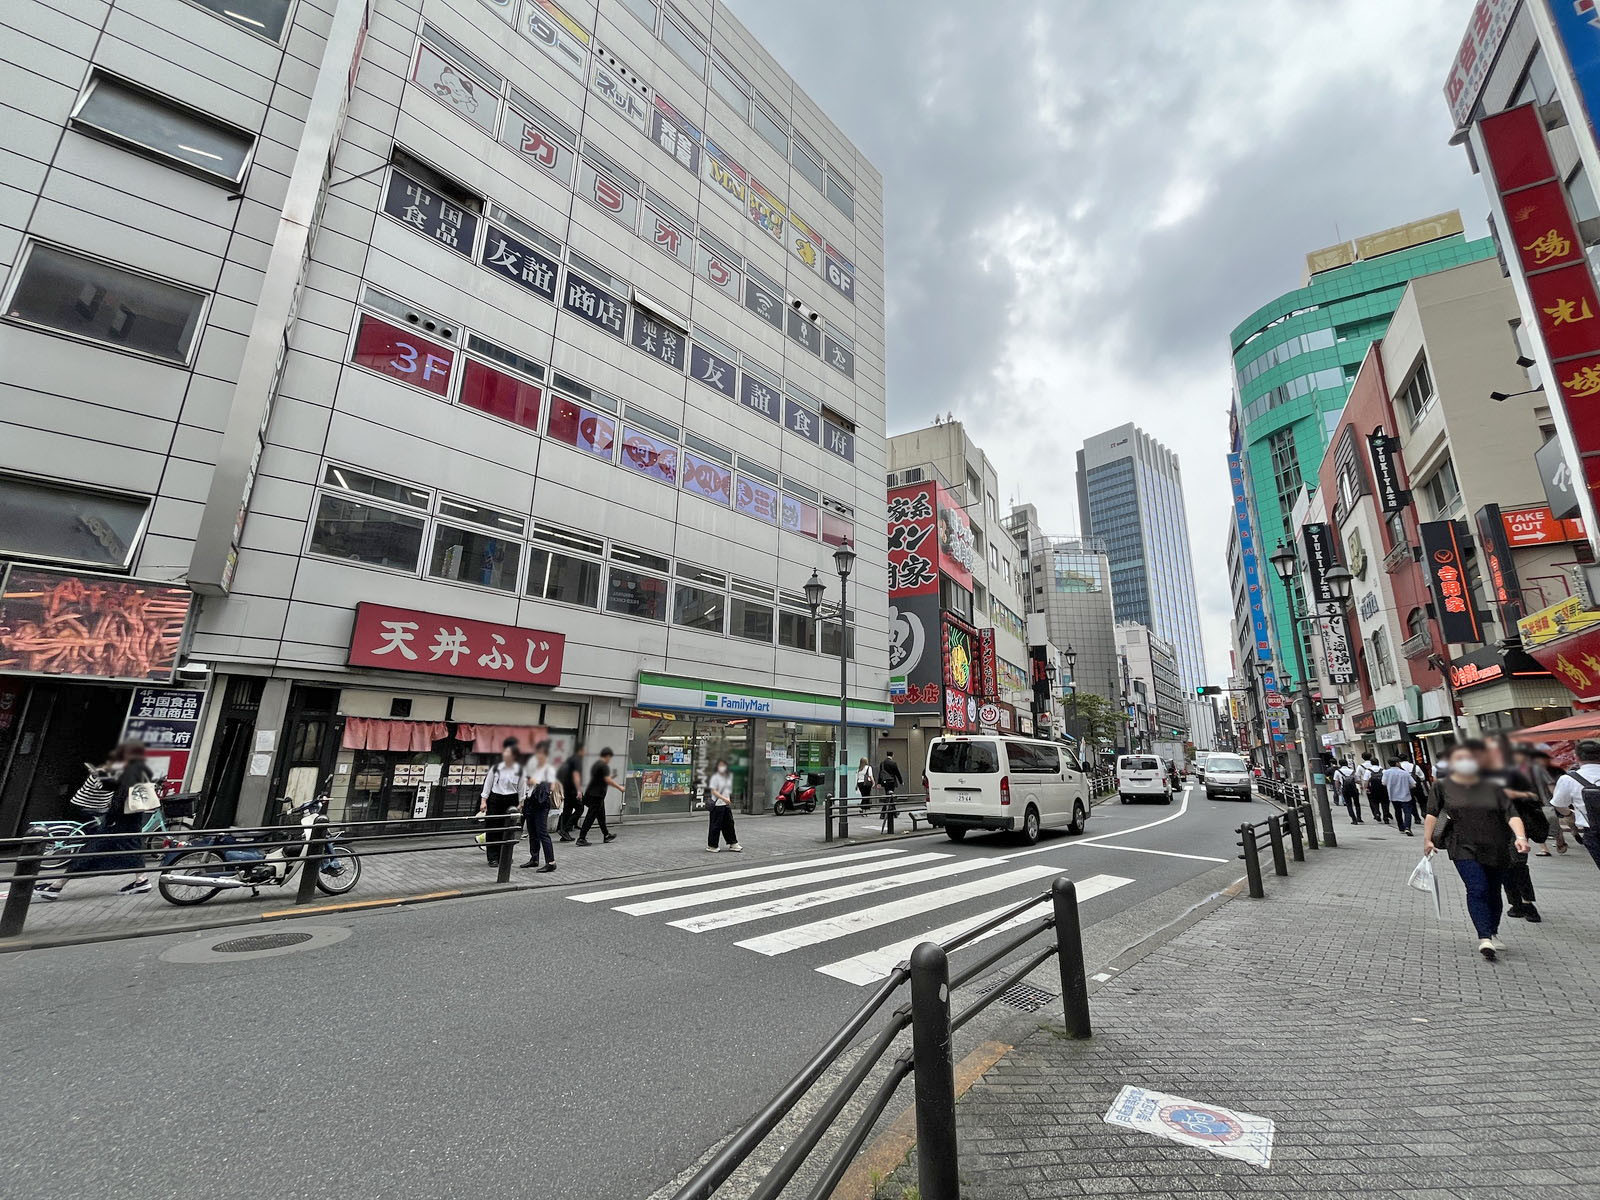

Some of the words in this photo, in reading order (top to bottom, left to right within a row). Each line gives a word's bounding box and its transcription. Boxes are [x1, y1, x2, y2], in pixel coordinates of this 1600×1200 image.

[406, 185, 463, 229] 中国
[402, 205, 458, 248] 食品
[487, 238, 623, 331] 友誼商店
[829, 265, 850, 291] 6F
[643, 319, 677, 349] 池袋
[390, 342, 450, 381] 3F
[641, 336, 676, 365] 本店
[702, 357, 847, 456] 友誼食府
[1505, 512, 1545, 523] TAKE
[1512, 522, 1542, 532] OUT
[371, 621, 550, 674] 天丼ふじ
[1334, 675, 1350, 683] B1
[138, 707, 195, 719] 友誼商店
[142, 696, 197, 708] 中国食品
[721, 696, 770, 713] FamilyMart
